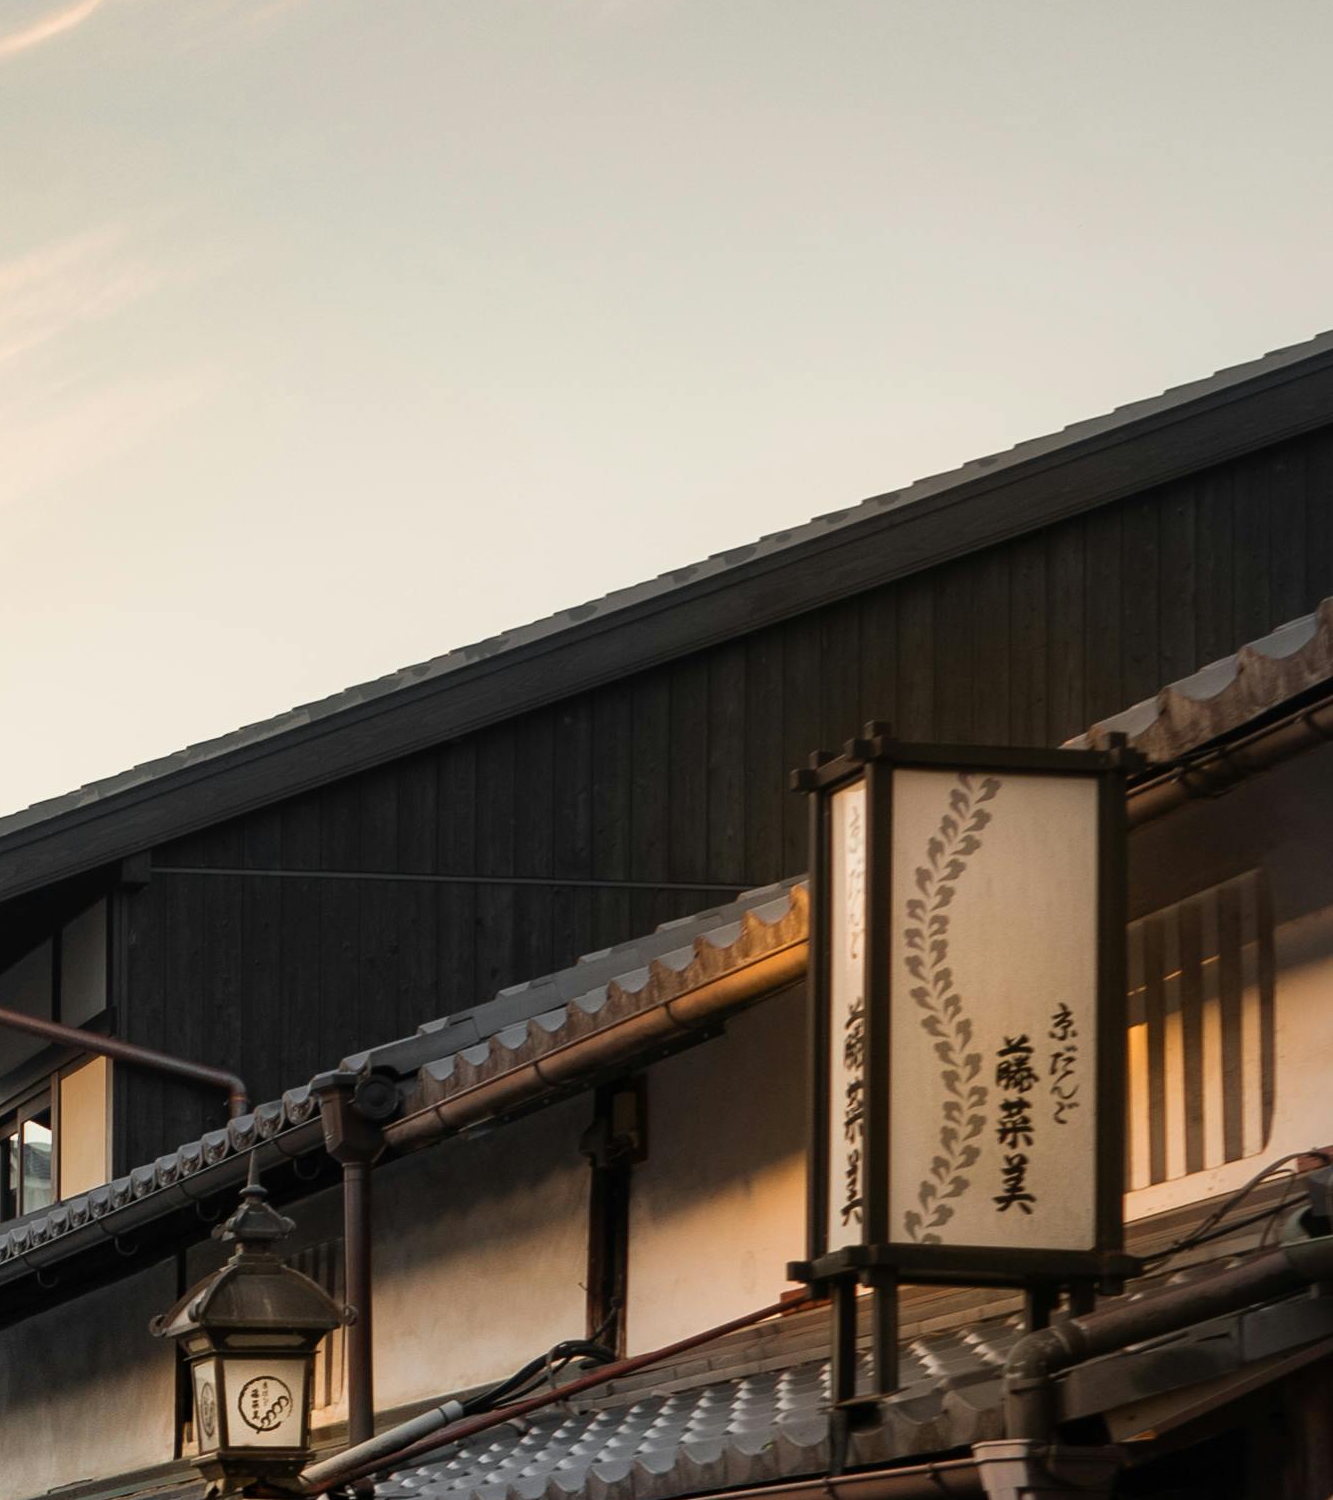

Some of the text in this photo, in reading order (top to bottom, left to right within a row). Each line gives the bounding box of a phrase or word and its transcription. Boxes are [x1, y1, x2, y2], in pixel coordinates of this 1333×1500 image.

[992, 1034, 1039, 1215] 藤菜美
[1047, 1002, 1080, 1125] 京だんご
